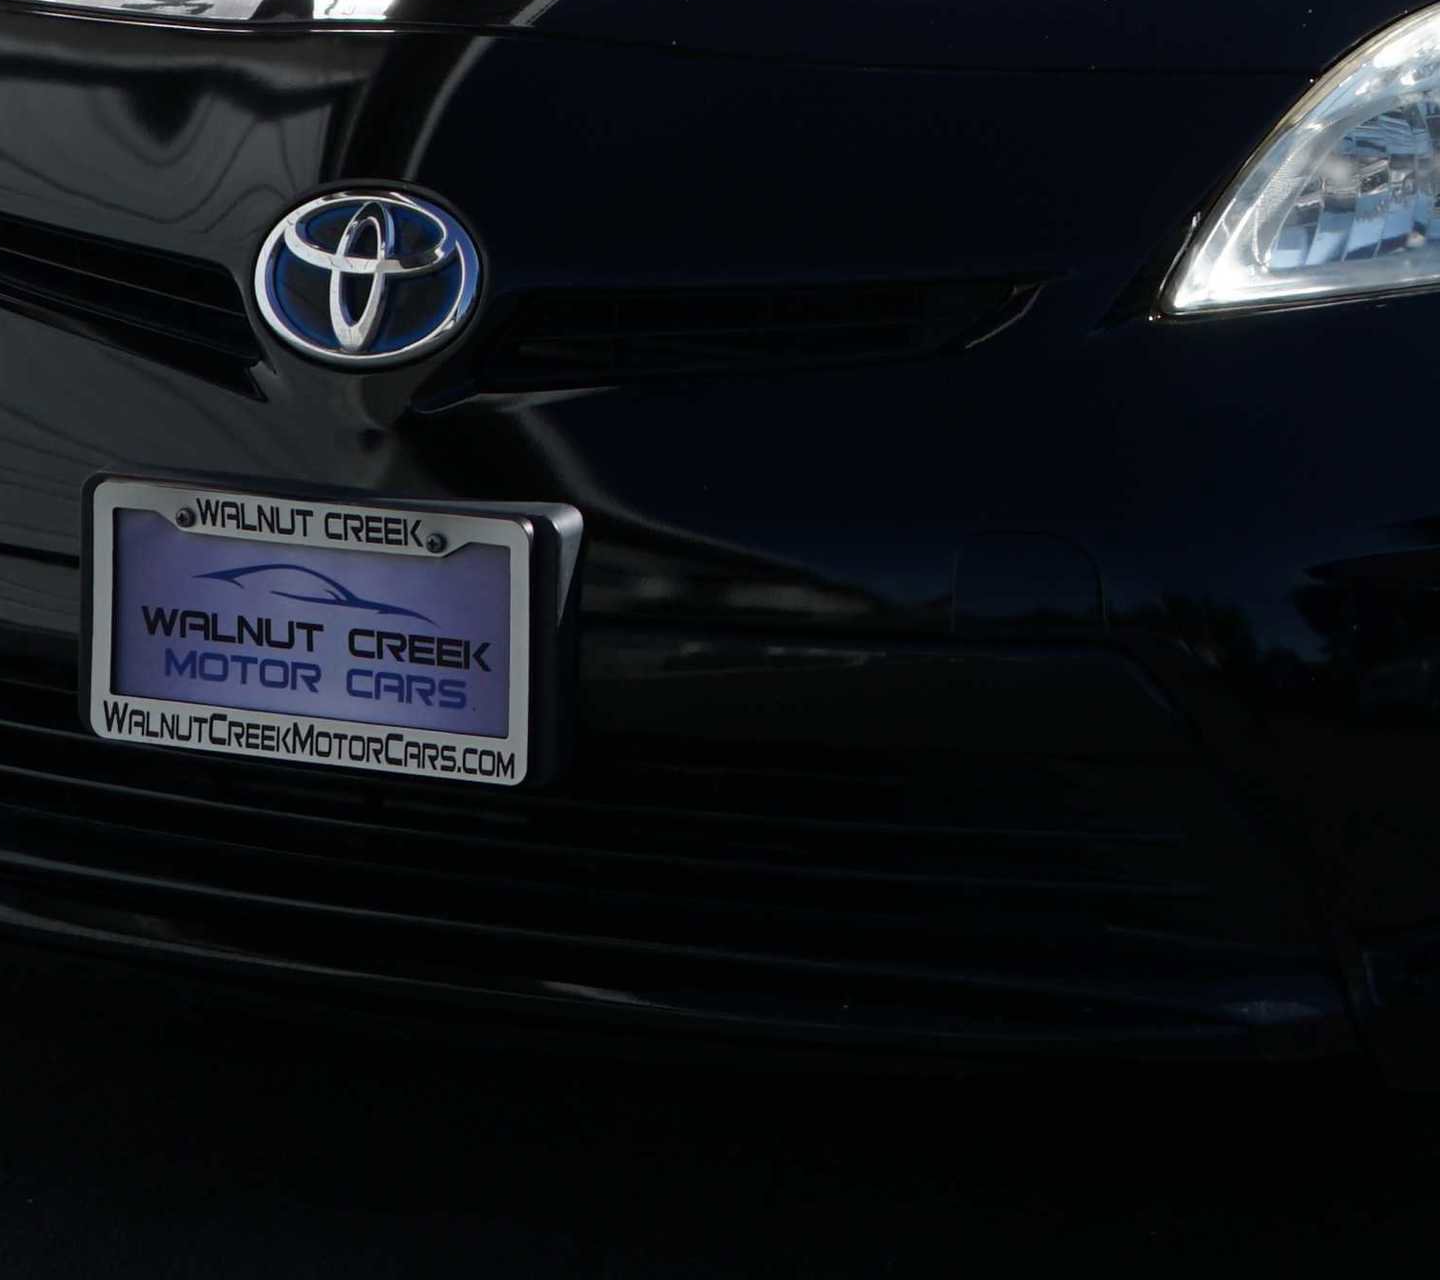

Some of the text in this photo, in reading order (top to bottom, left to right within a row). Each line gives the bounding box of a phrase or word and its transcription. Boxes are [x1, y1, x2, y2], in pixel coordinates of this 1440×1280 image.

[196, 497, 424, 548] WALNUT CREEK
[141, 605, 492, 673] WALNUT CREEK
[164, 647, 467, 710] MOTOR CARS
